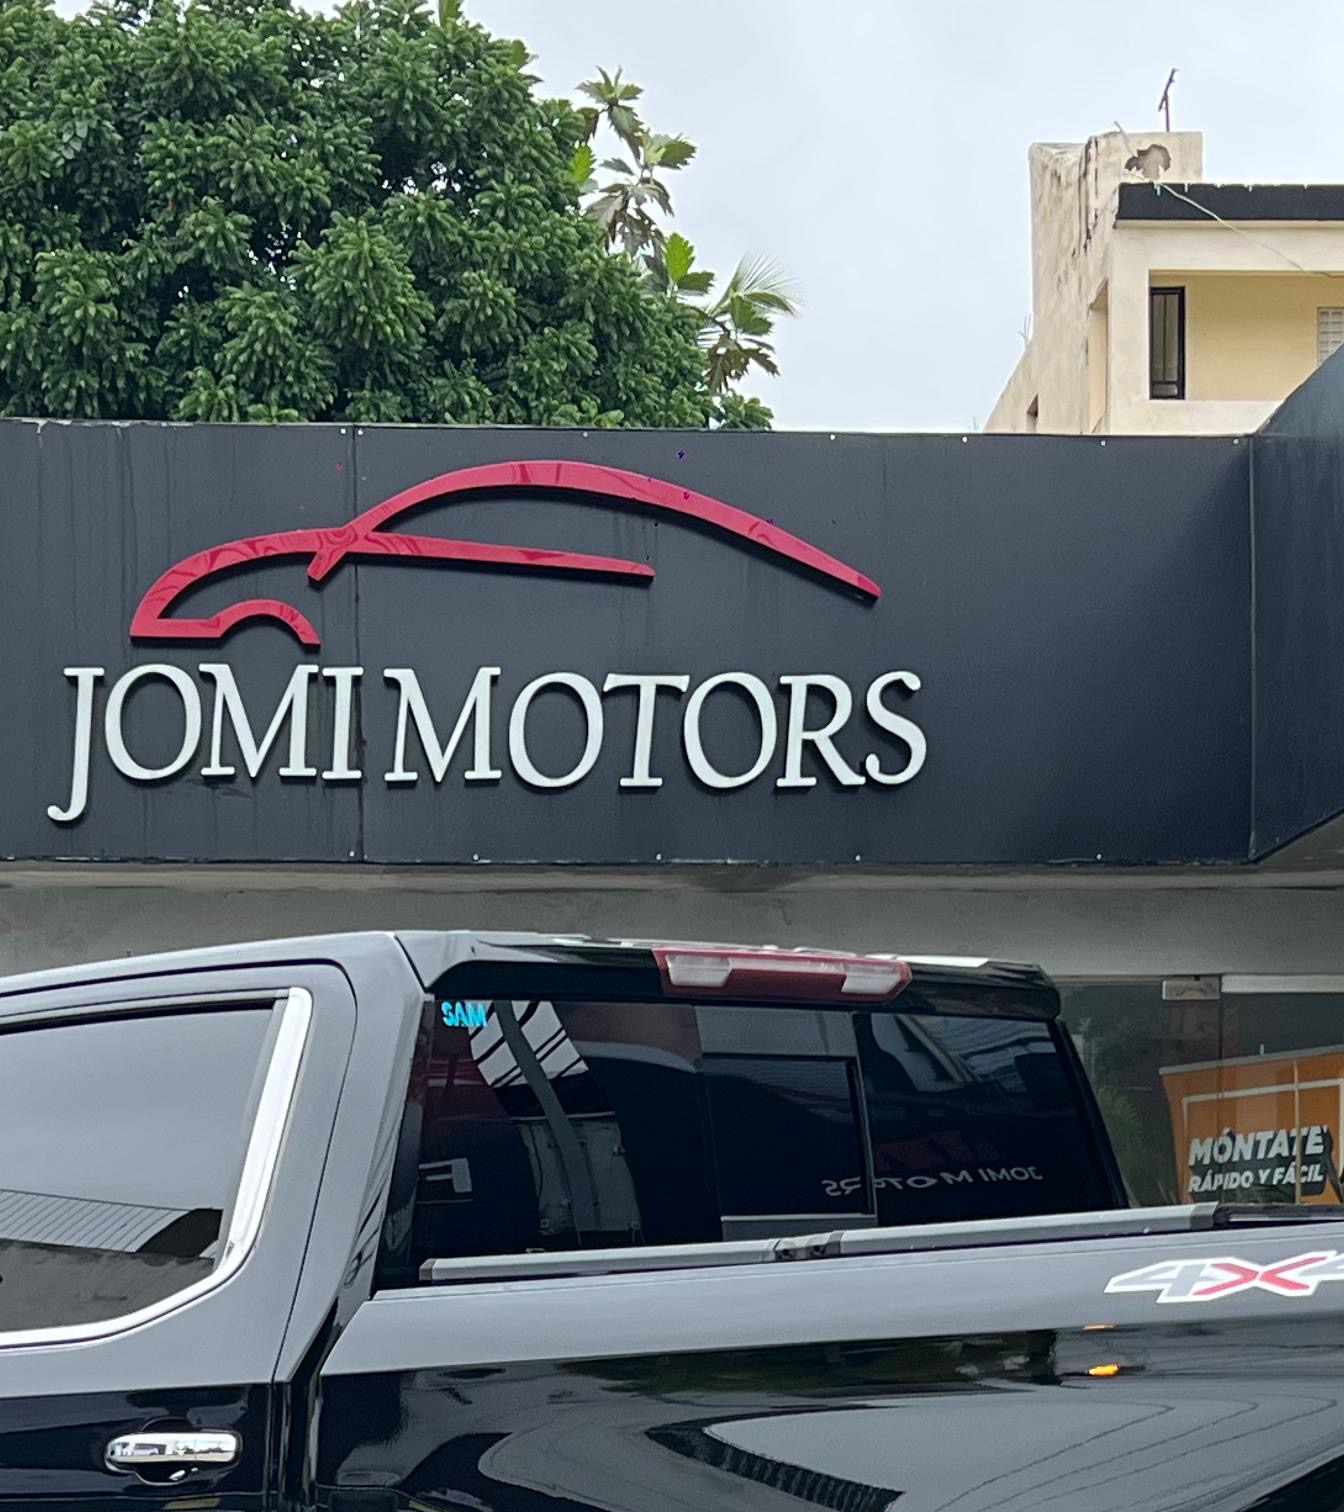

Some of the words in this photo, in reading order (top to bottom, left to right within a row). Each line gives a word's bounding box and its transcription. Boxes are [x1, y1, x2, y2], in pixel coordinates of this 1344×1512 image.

[47, 663, 365, 823] JOMI
[383, 667, 928, 789] MOTORS
[441, 1001, 488, 1028] SAM
[1187, 1168, 1253, 1193] RÁPIDO
[1259, 1168, 1273, 1185] Y
[1272, 1161, 1324, 1185] FÁCIL
